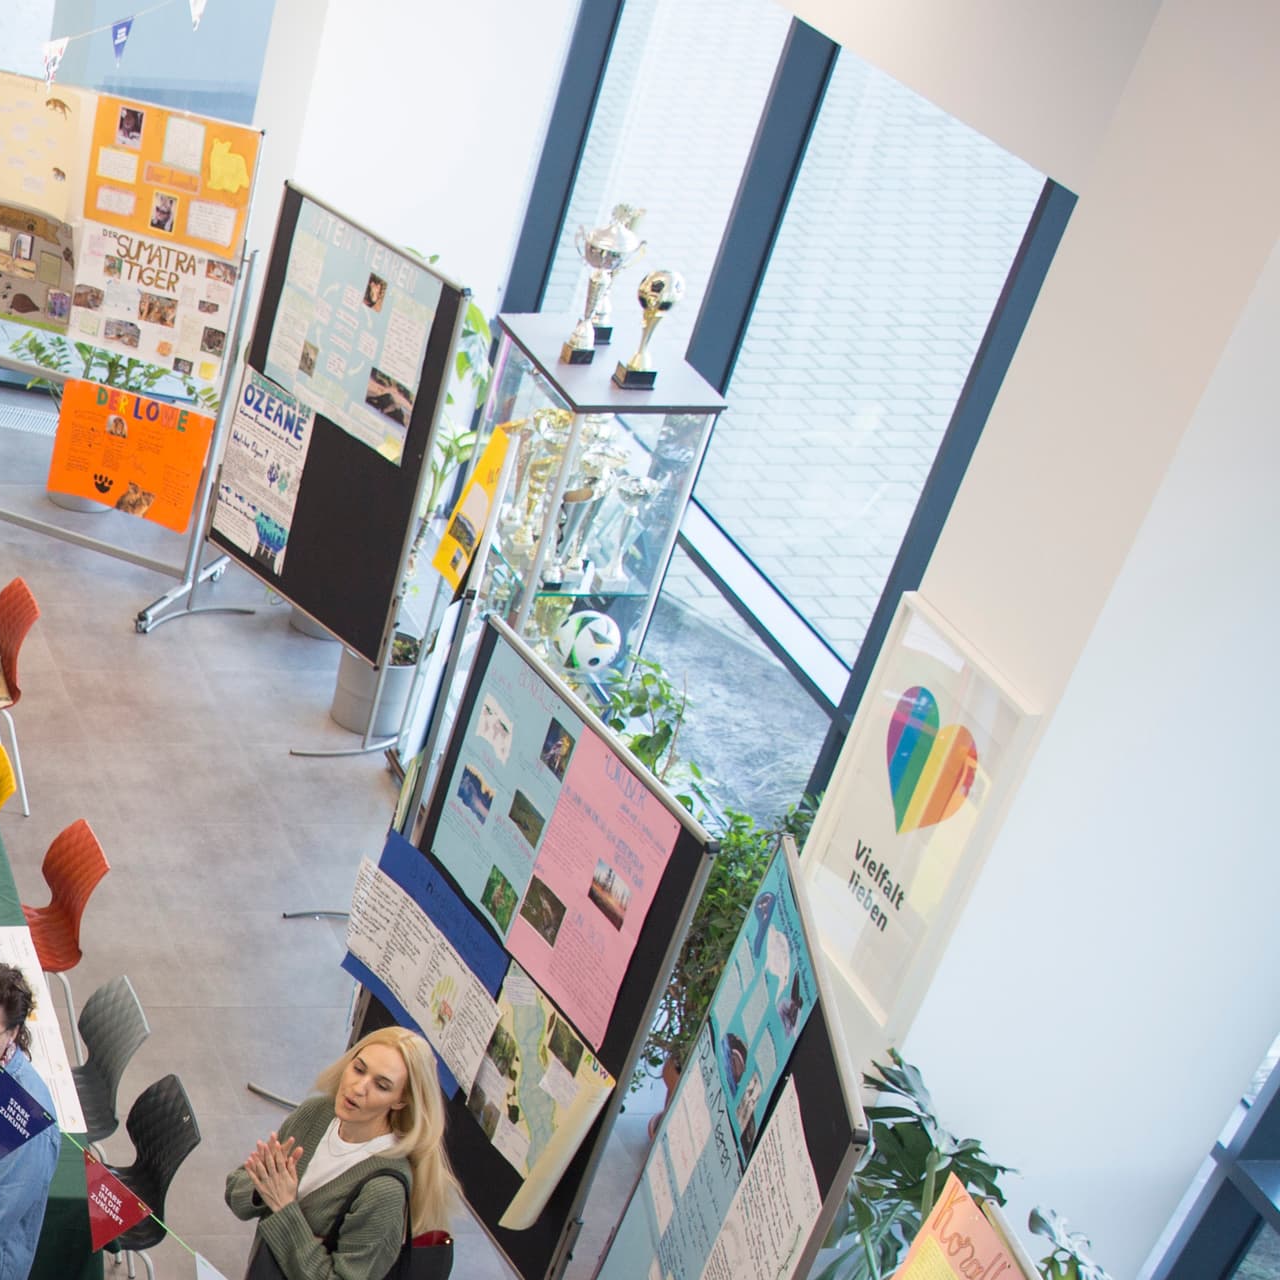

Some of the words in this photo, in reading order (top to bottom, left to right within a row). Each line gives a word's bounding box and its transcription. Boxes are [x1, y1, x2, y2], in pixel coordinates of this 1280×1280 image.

[116, 233, 196, 276] SUMATRA
[124, 259, 180, 293] TIGER
[96, 387, 129, 414] DER
[243, 383, 307, 441] OZEANE
[854, 839, 904, 912] Vielfalt
[847, 870, 888, 932] lieben
[0, 1106, 31, 1139] ZUKUNFT
[9, 1097, 30, 1121] STARK
[90, 1192, 124, 1225] ZUKUNFT
[101, 1184, 123, 1207] STARK
